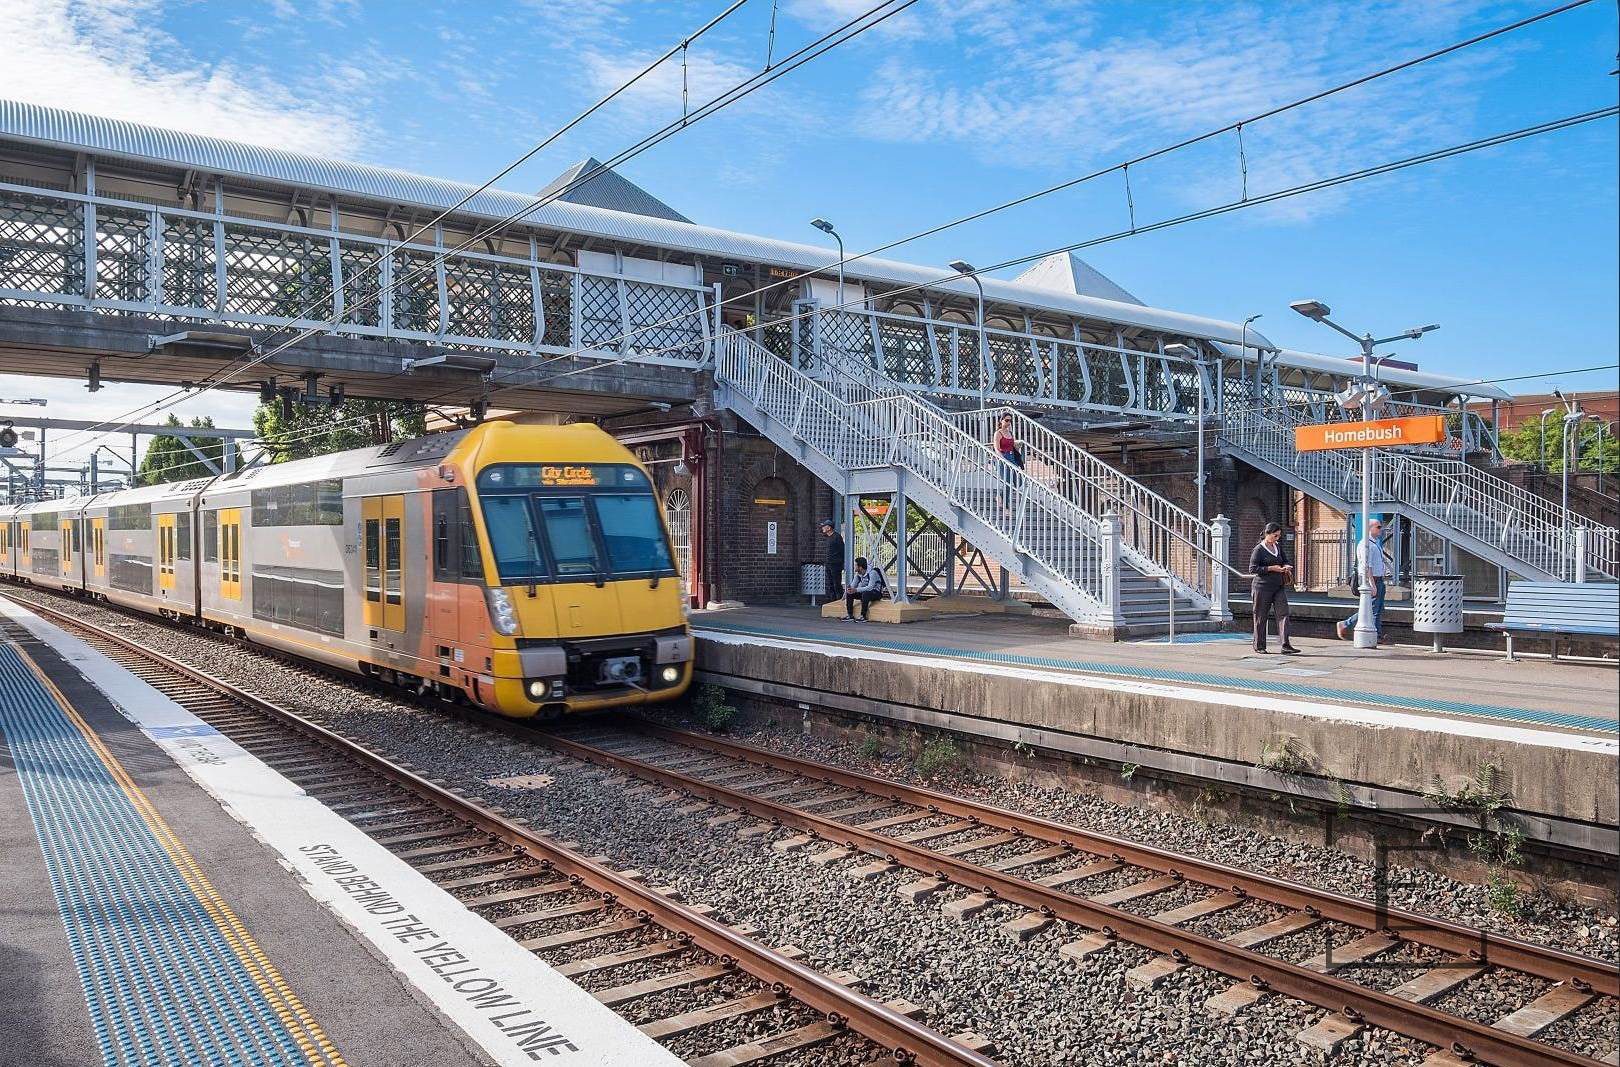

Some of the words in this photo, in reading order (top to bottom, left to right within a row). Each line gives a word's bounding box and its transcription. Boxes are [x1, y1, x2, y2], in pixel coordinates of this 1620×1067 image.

[1324, 425, 1402, 443] Homebush
[541, 466, 562, 479] City
[564, 466, 593, 479] Circle
[299, 844, 358, 875] STAND
[334, 871, 406, 915] BEHIND
[381, 914, 440, 944] THE
[413, 941, 520, 1010] YELLOW
[488, 1009, 580, 1061] LINE
